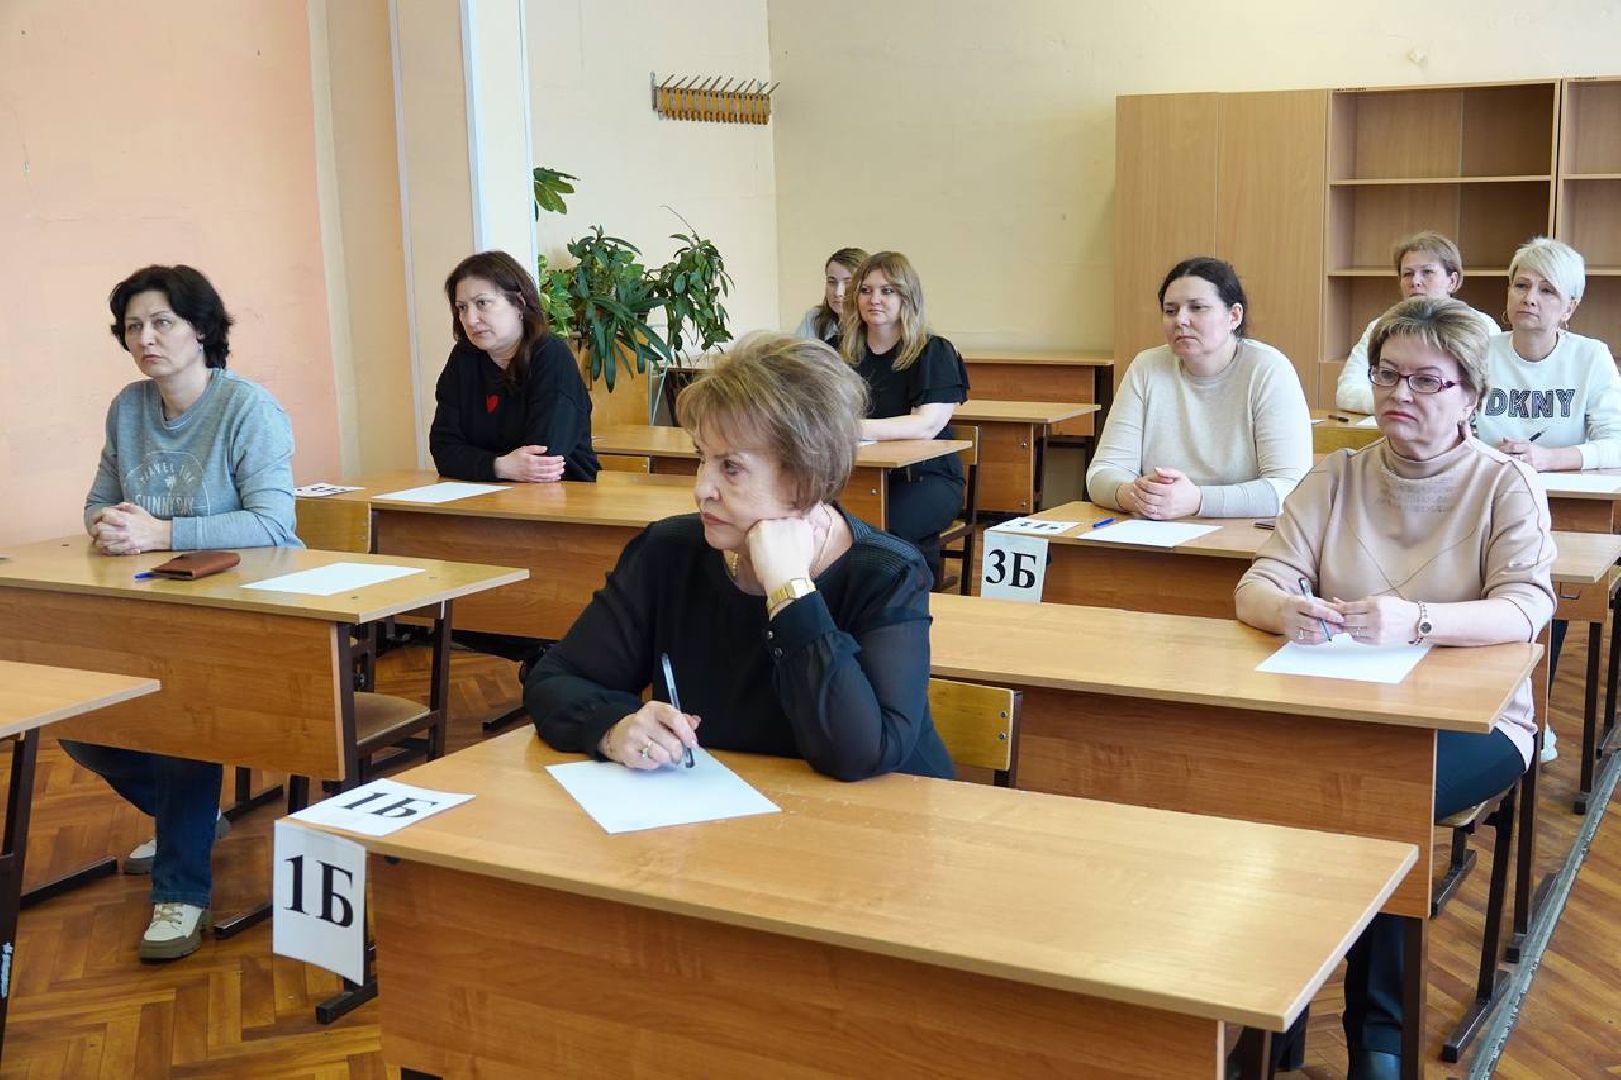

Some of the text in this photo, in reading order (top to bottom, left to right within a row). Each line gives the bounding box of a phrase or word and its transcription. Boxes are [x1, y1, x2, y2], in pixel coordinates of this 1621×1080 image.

[1485, 388, 1576, 418] DKNY
[985, 549, 1037, 588] 3Б
[341, 791, 439, 818] 1Б
[284, 854, 354, 928] 1Б
